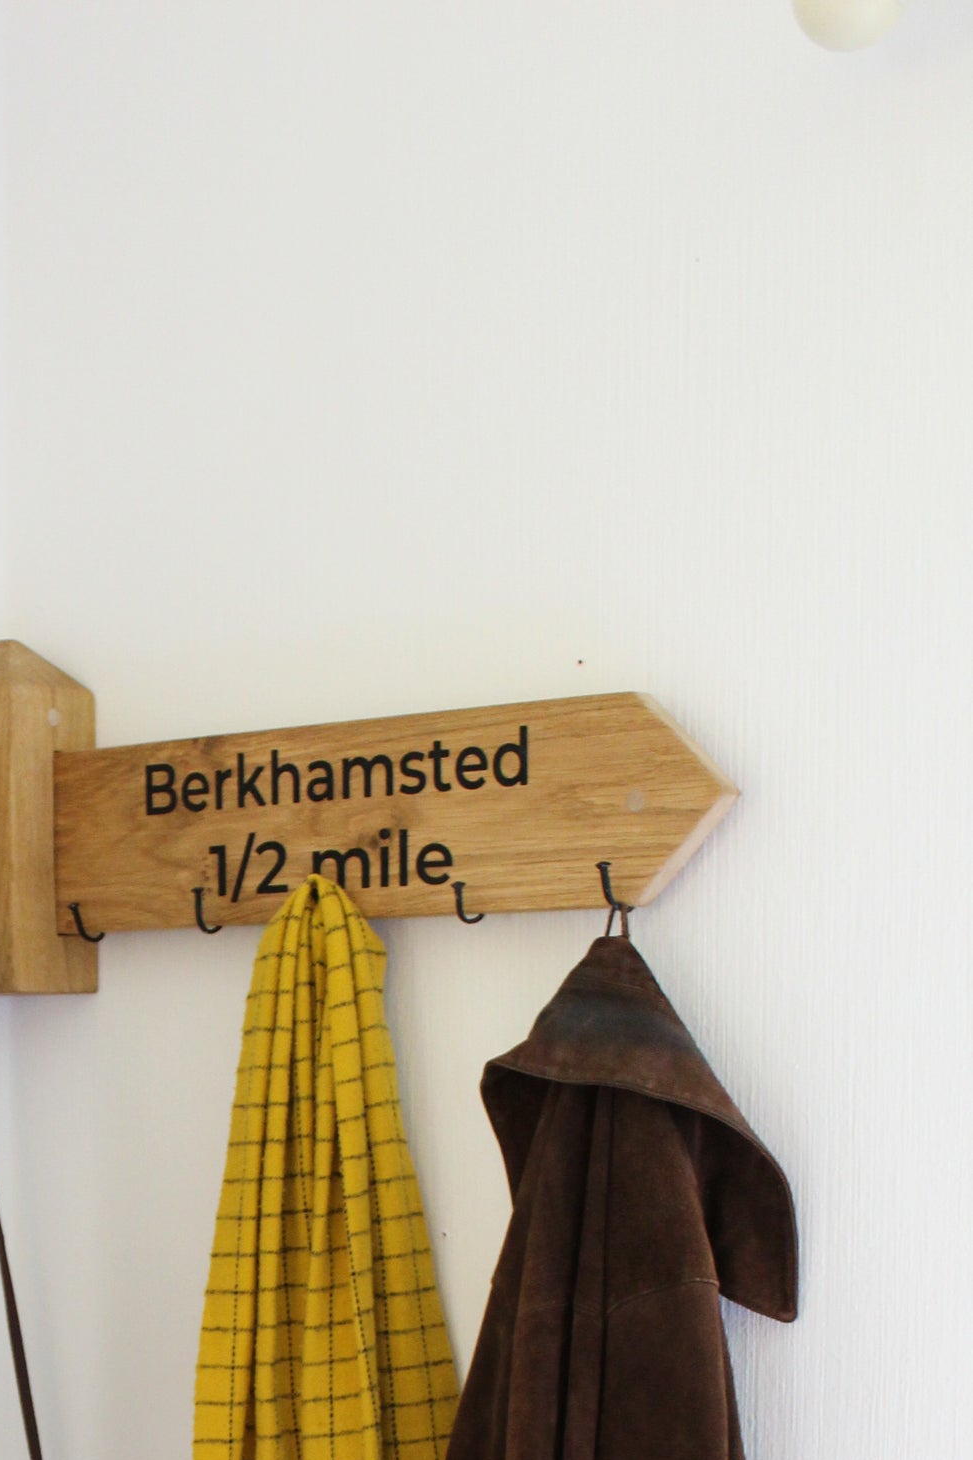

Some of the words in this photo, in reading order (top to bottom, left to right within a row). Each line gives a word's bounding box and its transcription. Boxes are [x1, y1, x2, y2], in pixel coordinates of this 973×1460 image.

[145, 725, 529, 816] Berkhamsted
[209, 832, 289, 902] 1/2
[312, 828, 453, 889] mile
